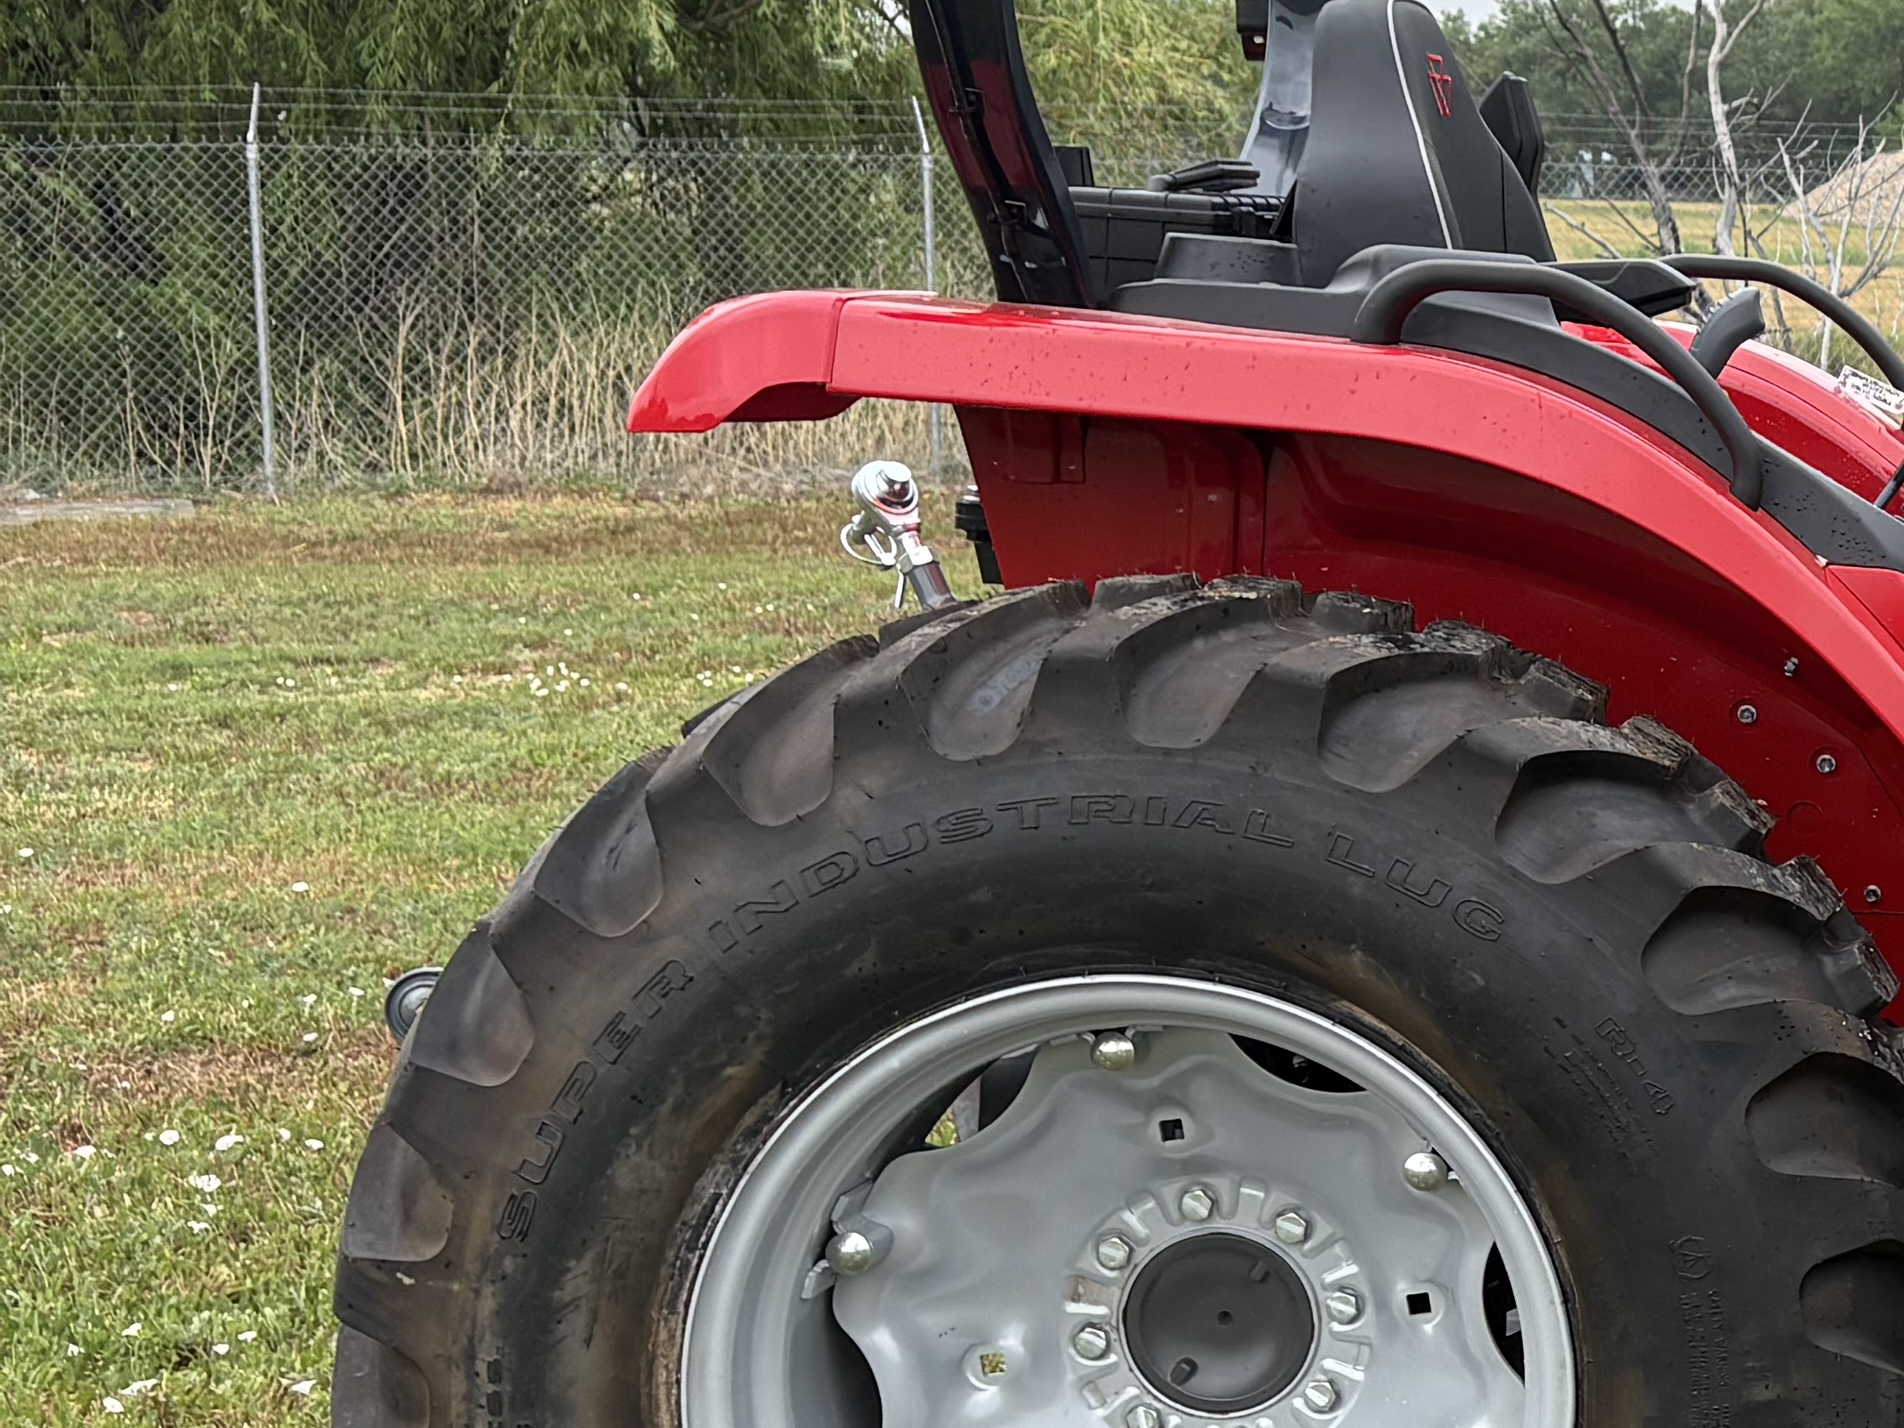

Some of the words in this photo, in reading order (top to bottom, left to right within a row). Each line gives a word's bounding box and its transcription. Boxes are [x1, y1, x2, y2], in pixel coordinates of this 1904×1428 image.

[494, 959, 696, 1243] SUPER
[705, 794, 1297, 956] INDUSTRIAL
[1325, 832, 1505, 942] LUG
